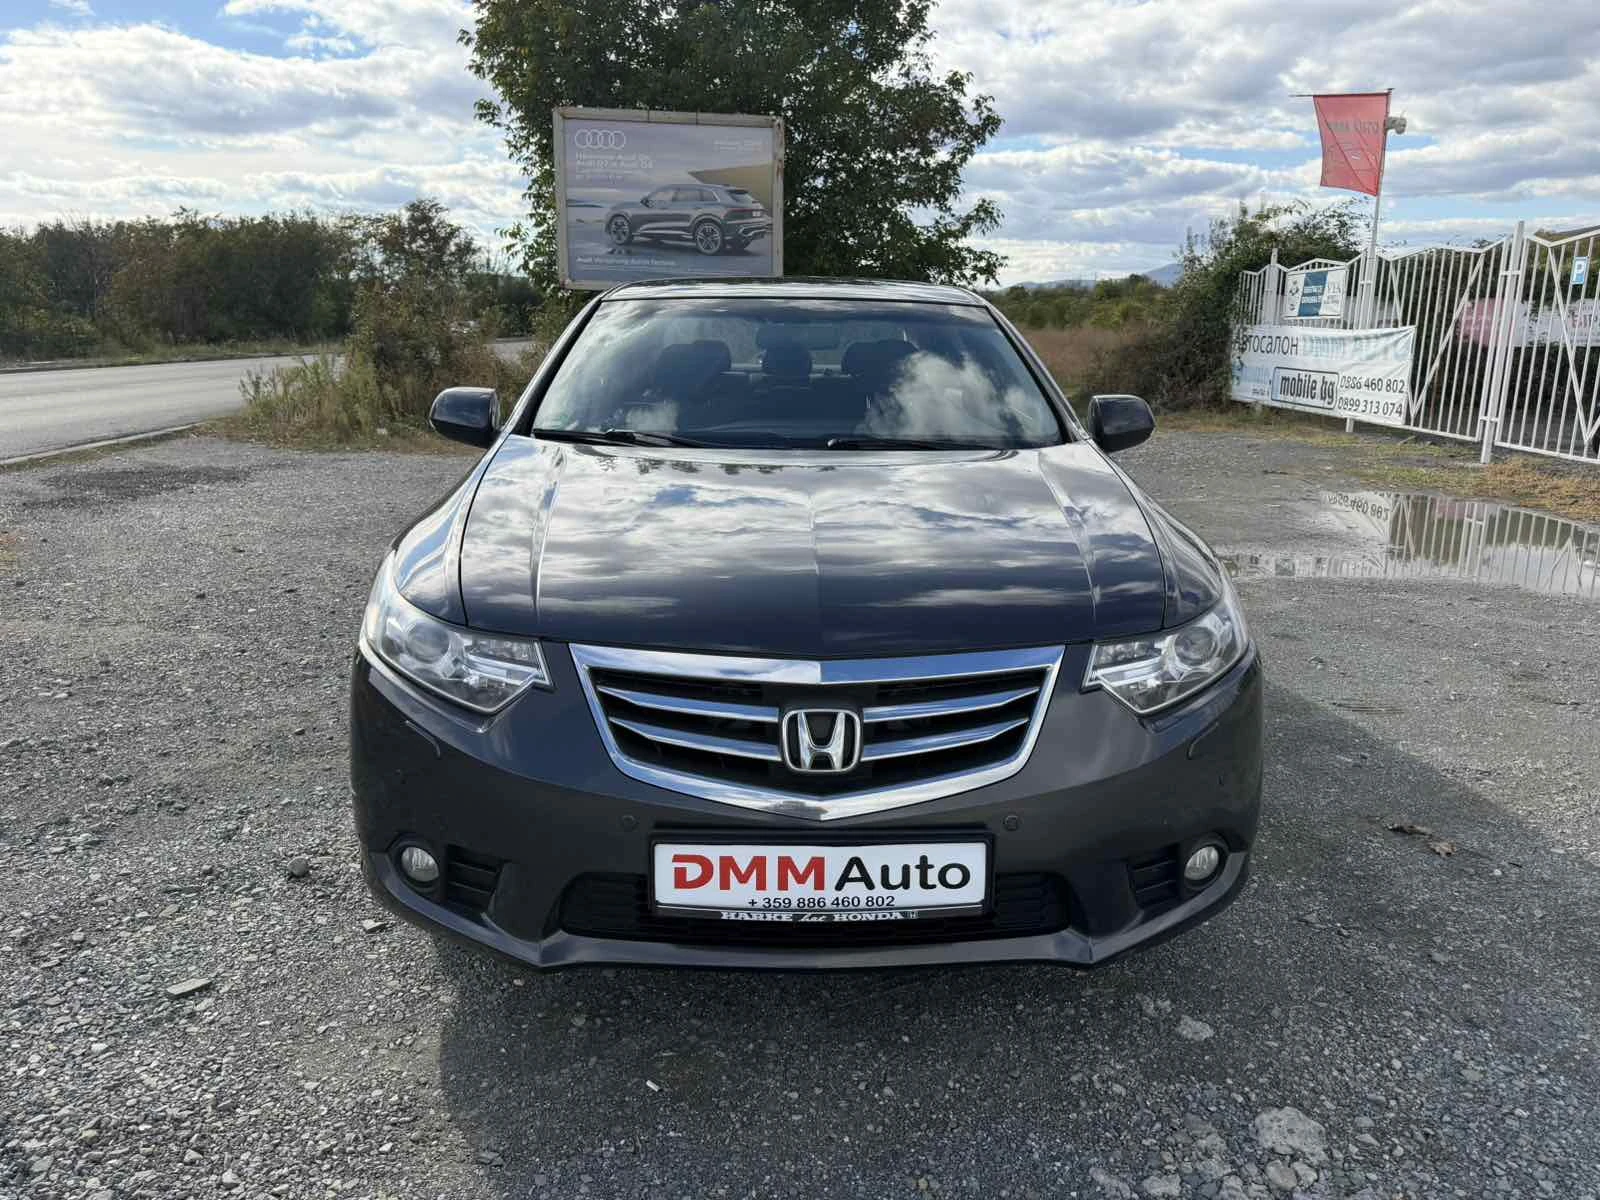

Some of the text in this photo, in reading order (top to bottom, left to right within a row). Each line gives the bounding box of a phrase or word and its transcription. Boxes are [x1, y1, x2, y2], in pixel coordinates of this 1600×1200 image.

[1573, 260, 1587, 282] P
[1340, 375, 1405, 393] 0886 460 802
[1338, 397, 1403, 417] 0899 313 074
[762, 897, 792, 909] 359
[797, 897, 826, 908] 886
[831, 896, 861, 908] 460
[866, 895, 896, 907] 802
[832, 911, 905, 922] HONDA
